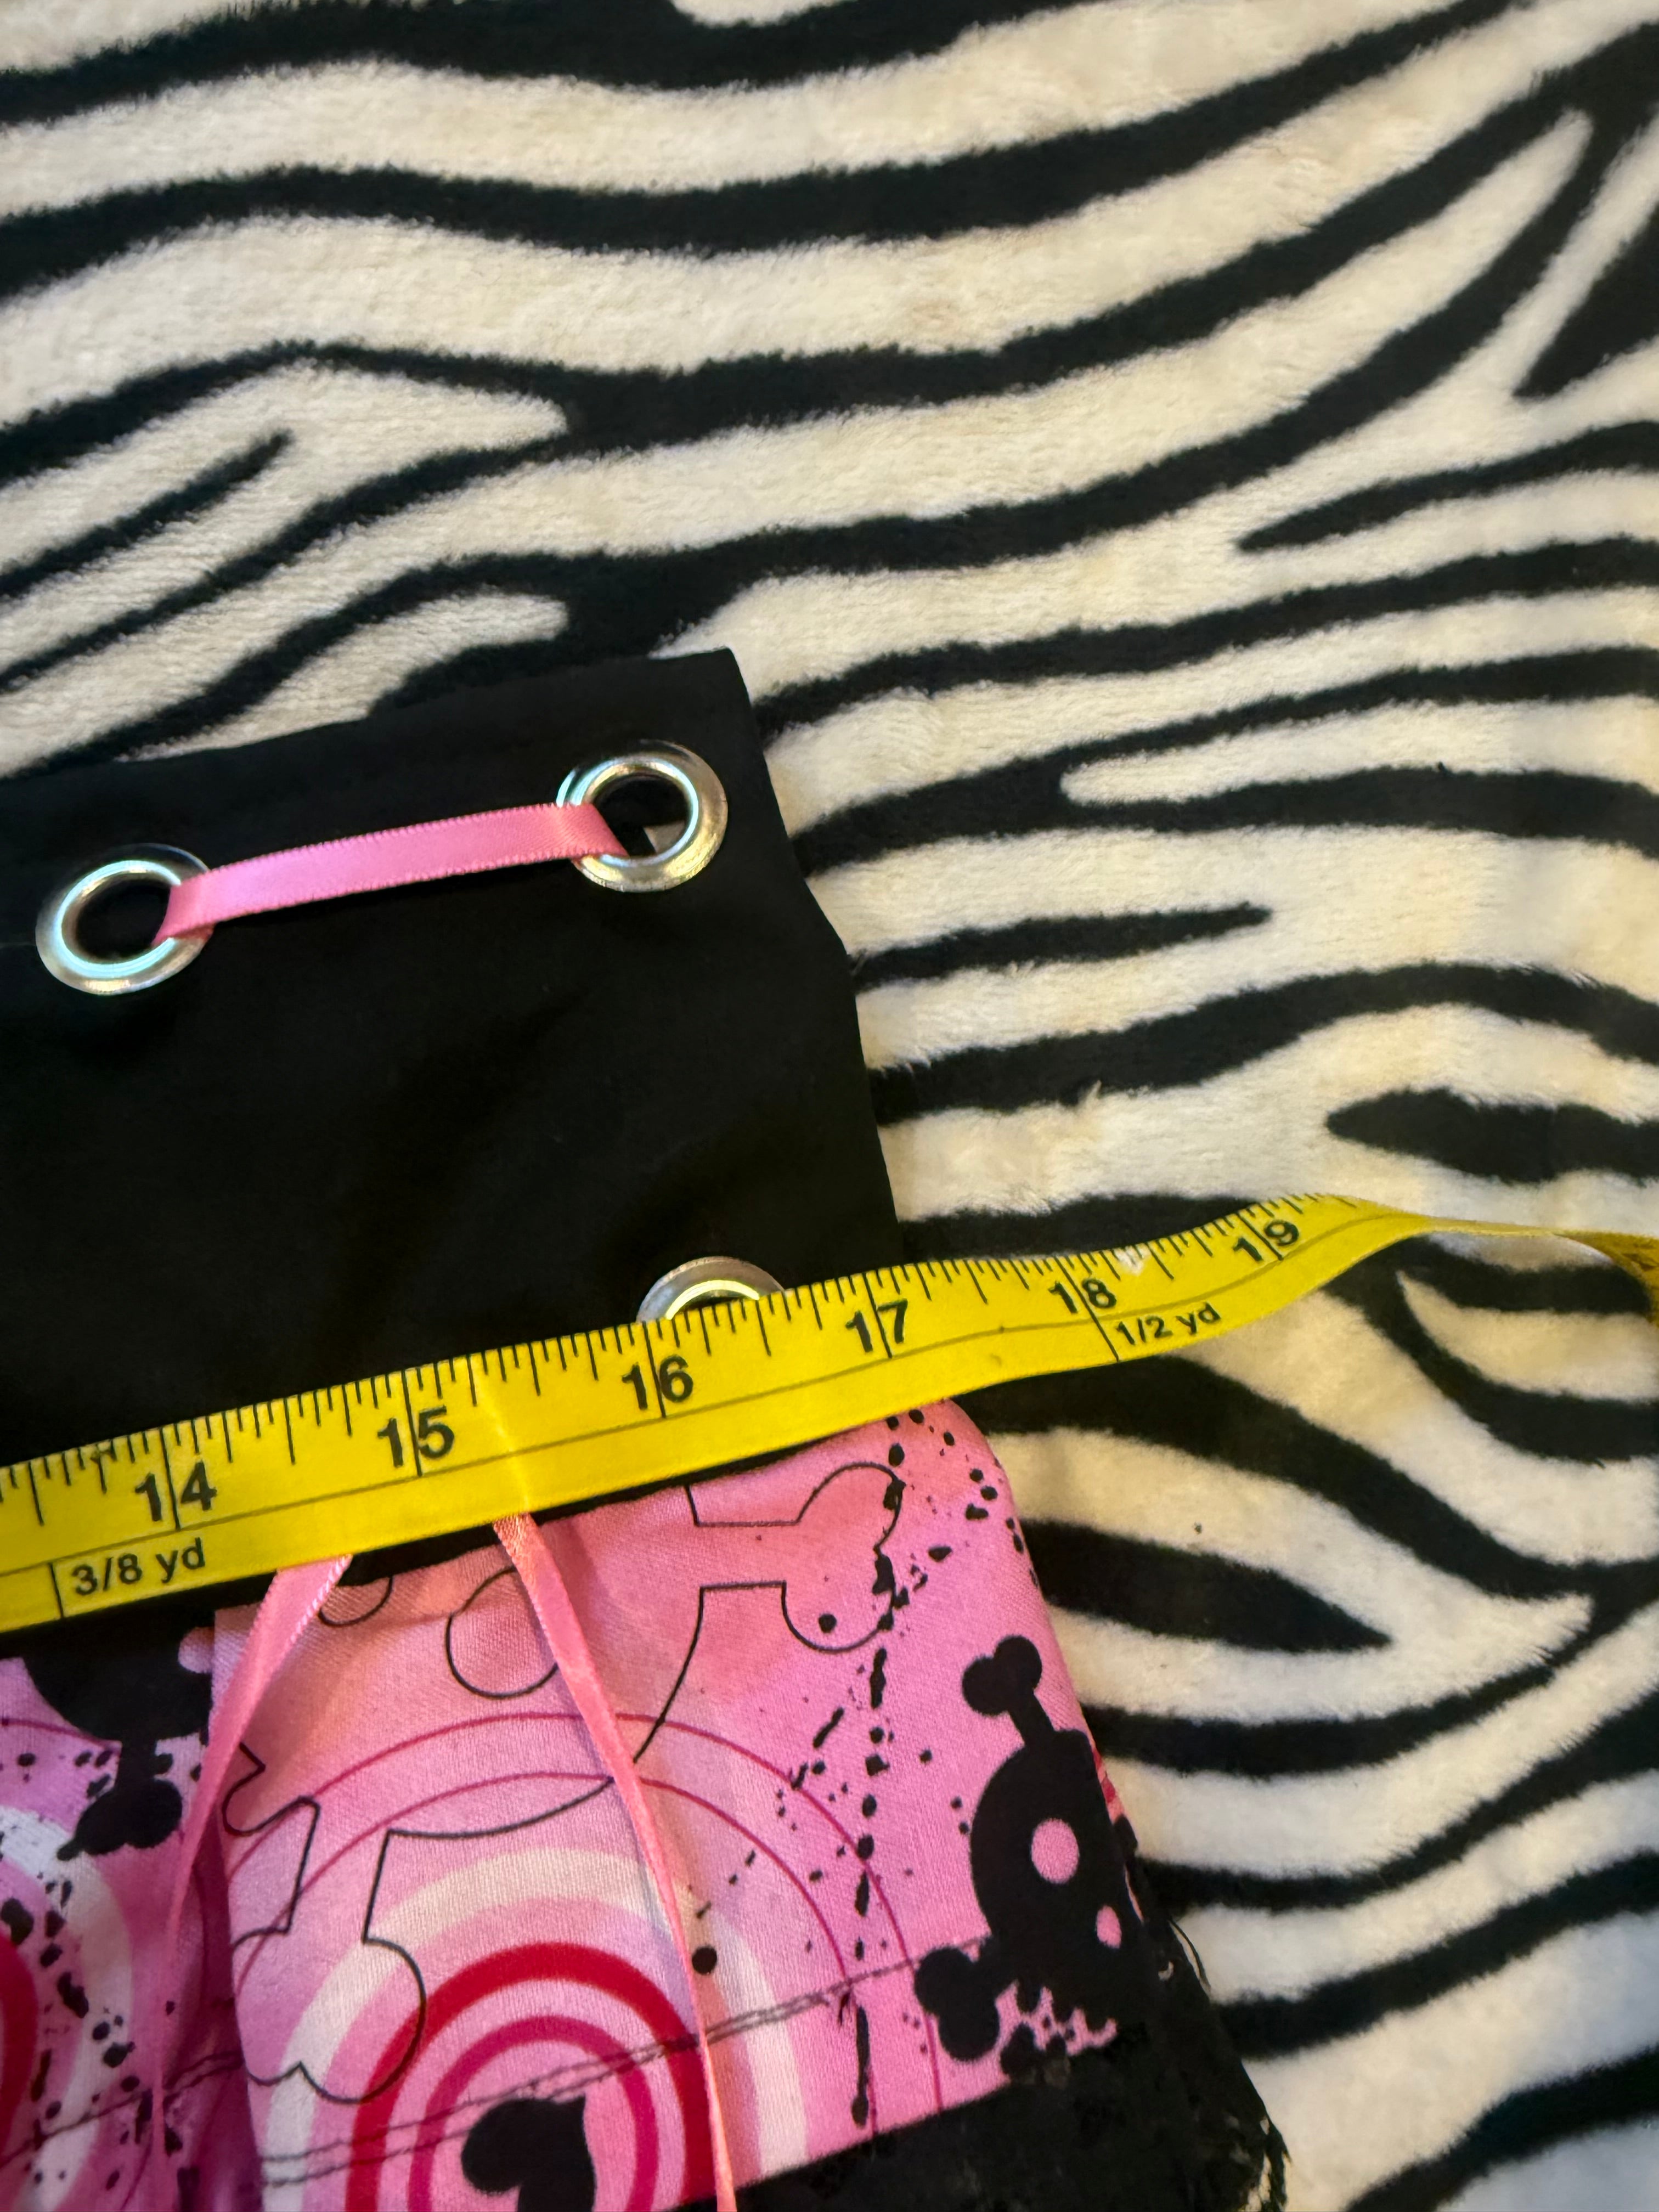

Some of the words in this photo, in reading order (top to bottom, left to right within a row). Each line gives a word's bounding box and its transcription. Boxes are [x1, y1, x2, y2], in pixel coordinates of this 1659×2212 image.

[1233, 1218, 1300, 1262] 19
[1048, 1277, 1118, 1314] 18
[845, 1299, 909, 1353] 17
[1114, 1316, 1173, 1346] 1/2
[1177, 1302, 1222, 1335] yd
[622, 1354, 694, 1410] 16
[377, 1405, 455, 1468] 15
[135, 1460, 217, 1522] 14
[71, 1553, 143, 1596] 3/8
[156, 1537, 206, 1583] yd
